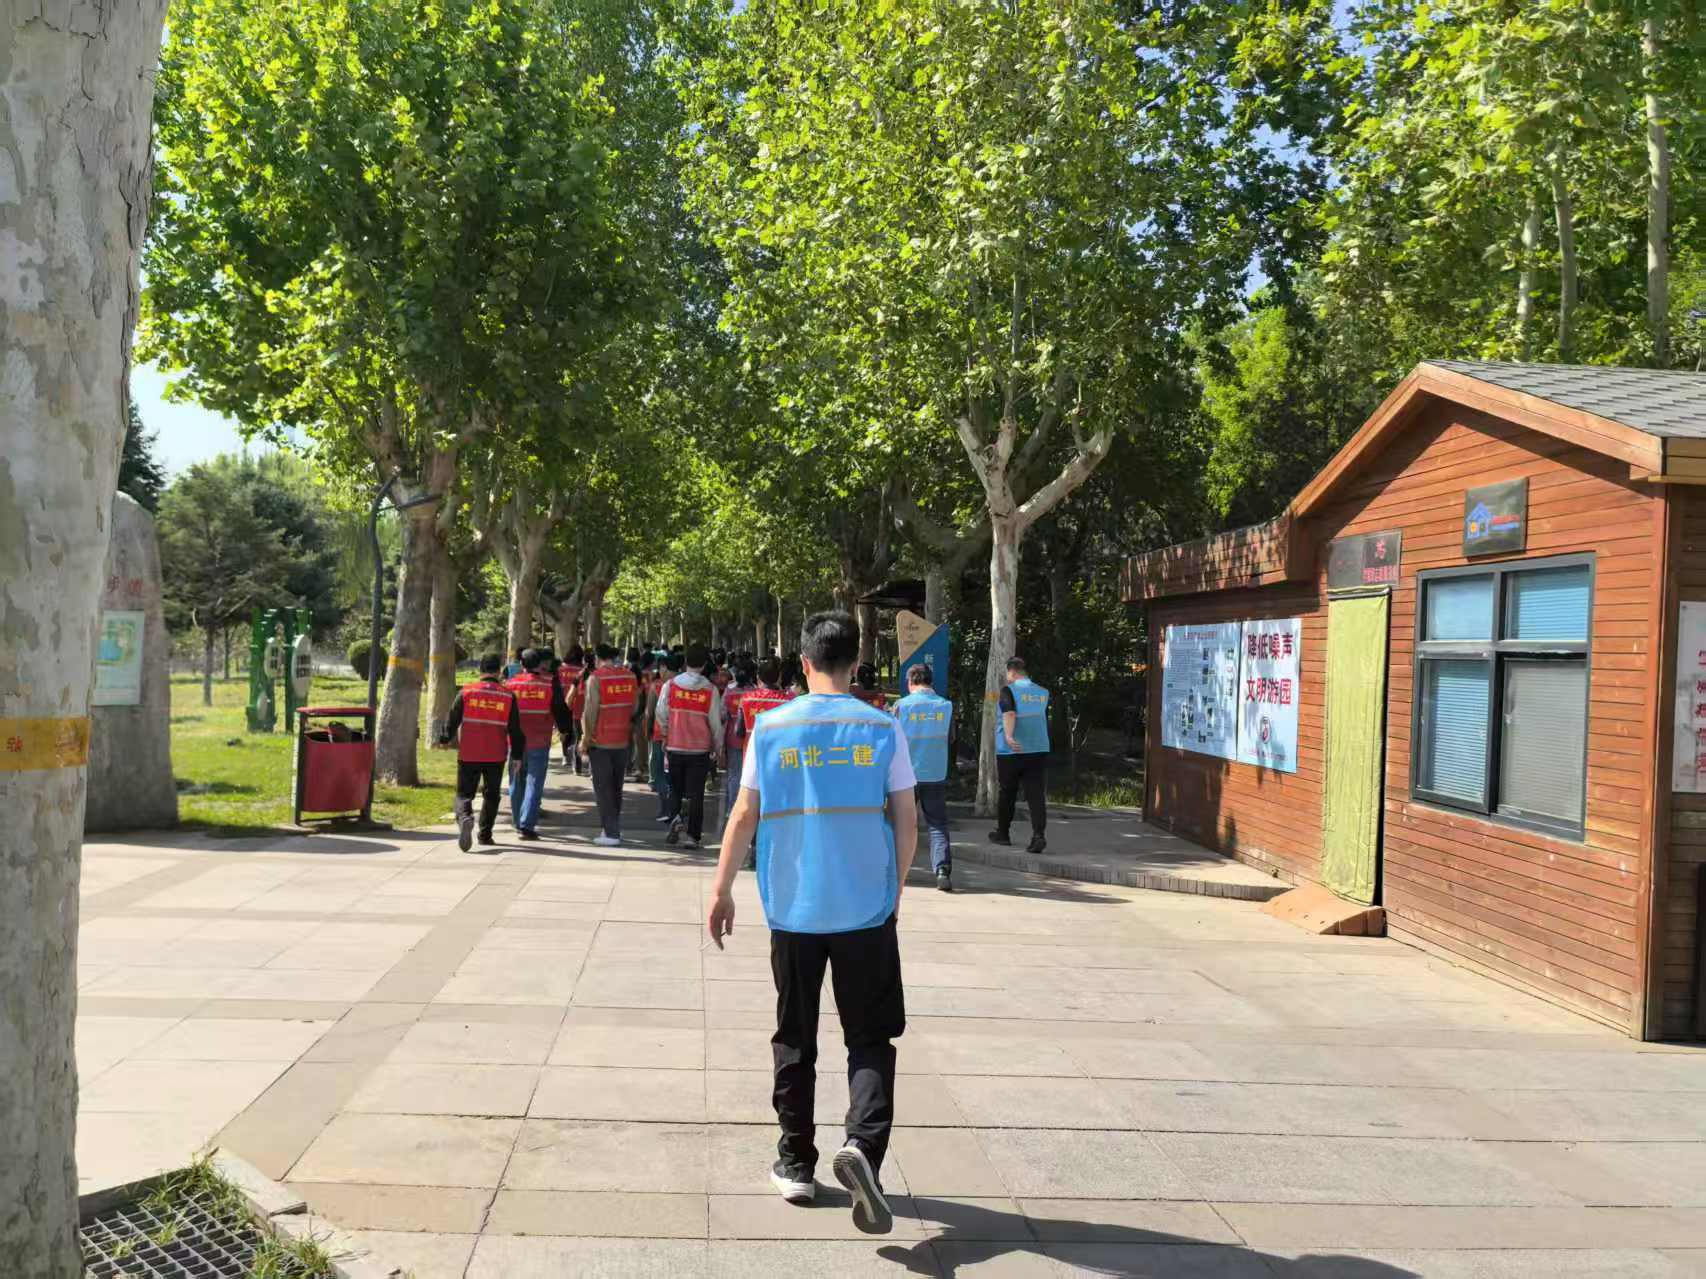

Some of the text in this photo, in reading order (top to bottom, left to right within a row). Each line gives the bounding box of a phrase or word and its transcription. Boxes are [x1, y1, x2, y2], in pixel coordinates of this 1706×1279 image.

[1247, 631, 1294, 661] 降低噪声
[1245, 676, 1293, 705] 文明游园
[779, 744, 881, 769] 河北二建
